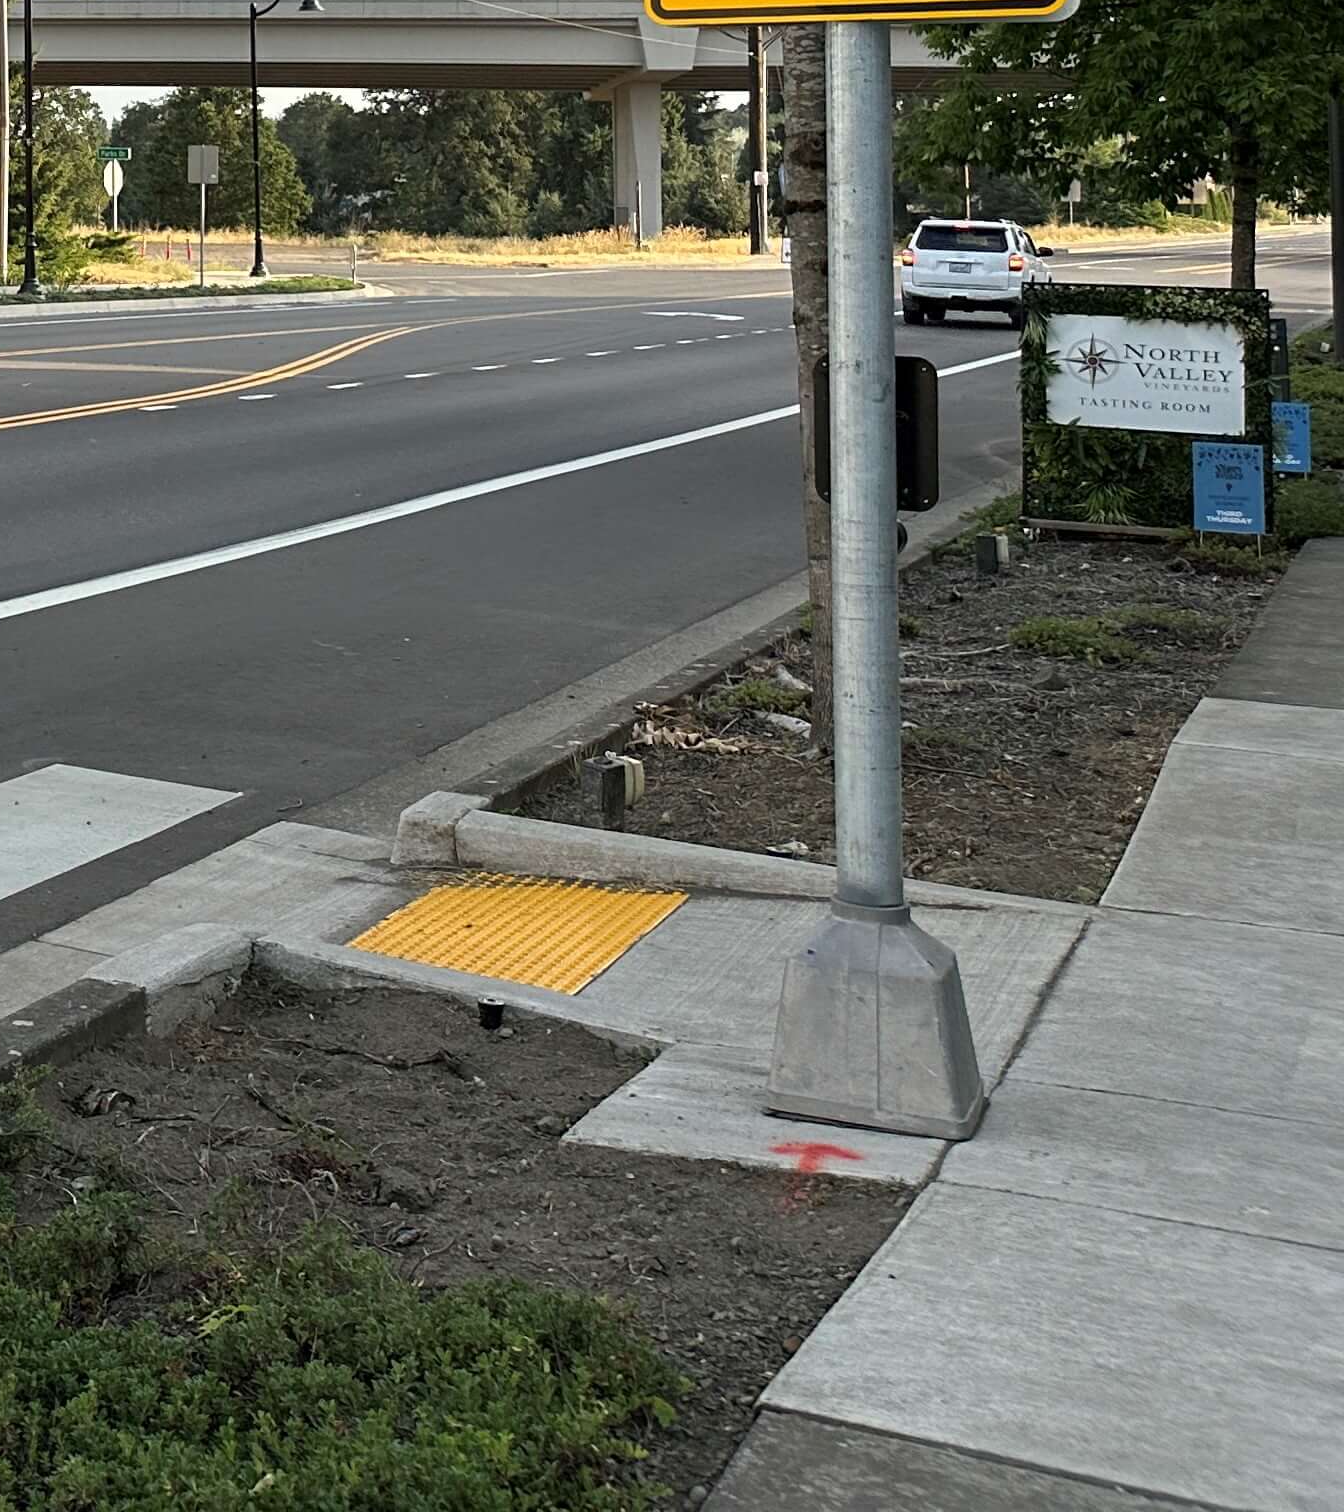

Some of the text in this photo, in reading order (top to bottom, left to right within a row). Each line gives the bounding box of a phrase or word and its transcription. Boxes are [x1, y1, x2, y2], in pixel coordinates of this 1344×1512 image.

[1123, 343, 1221, 363] NORTH
[1133, 362, 1234, 383] VALLEY
[1144, 381, 1231, 393] VINEYARDS
[1079, 397, 1211, 414] TASTING ROOM
[1206, 515, 1253, 525] THURSDAY
